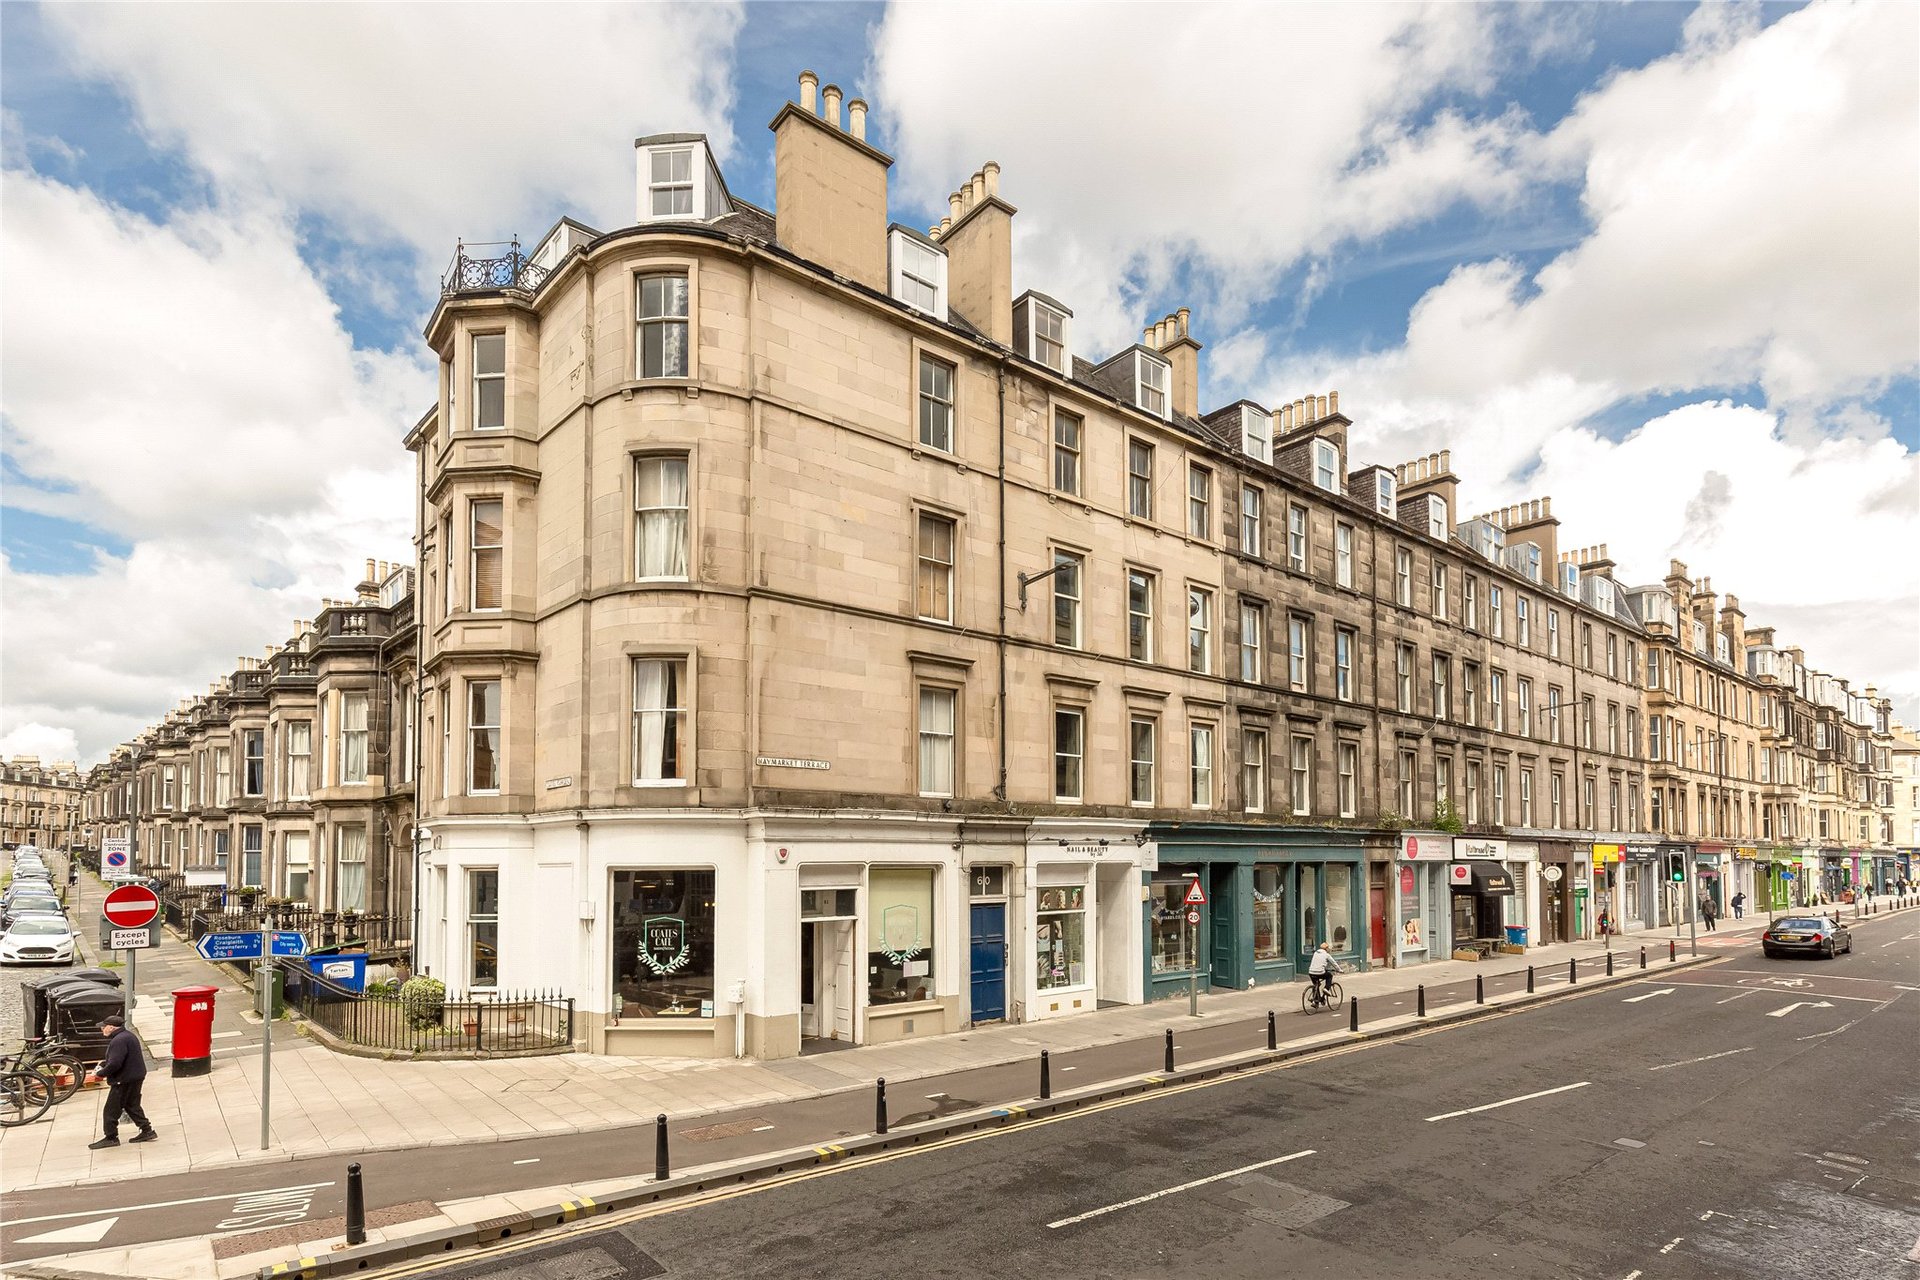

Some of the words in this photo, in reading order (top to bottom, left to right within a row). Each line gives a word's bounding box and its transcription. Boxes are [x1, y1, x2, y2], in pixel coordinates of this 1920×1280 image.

[757, 758, 798, 767] HAYMARKET
[800, 761, 828, 769] TERRACE
[976, 876, 991, 885] 60
[115, 931, 147, 939] Except
[650, 928, 678, 938] COATES
[655, 937, 672, 946] CAFE
[216, 1188, 317, 1229] SLOW
